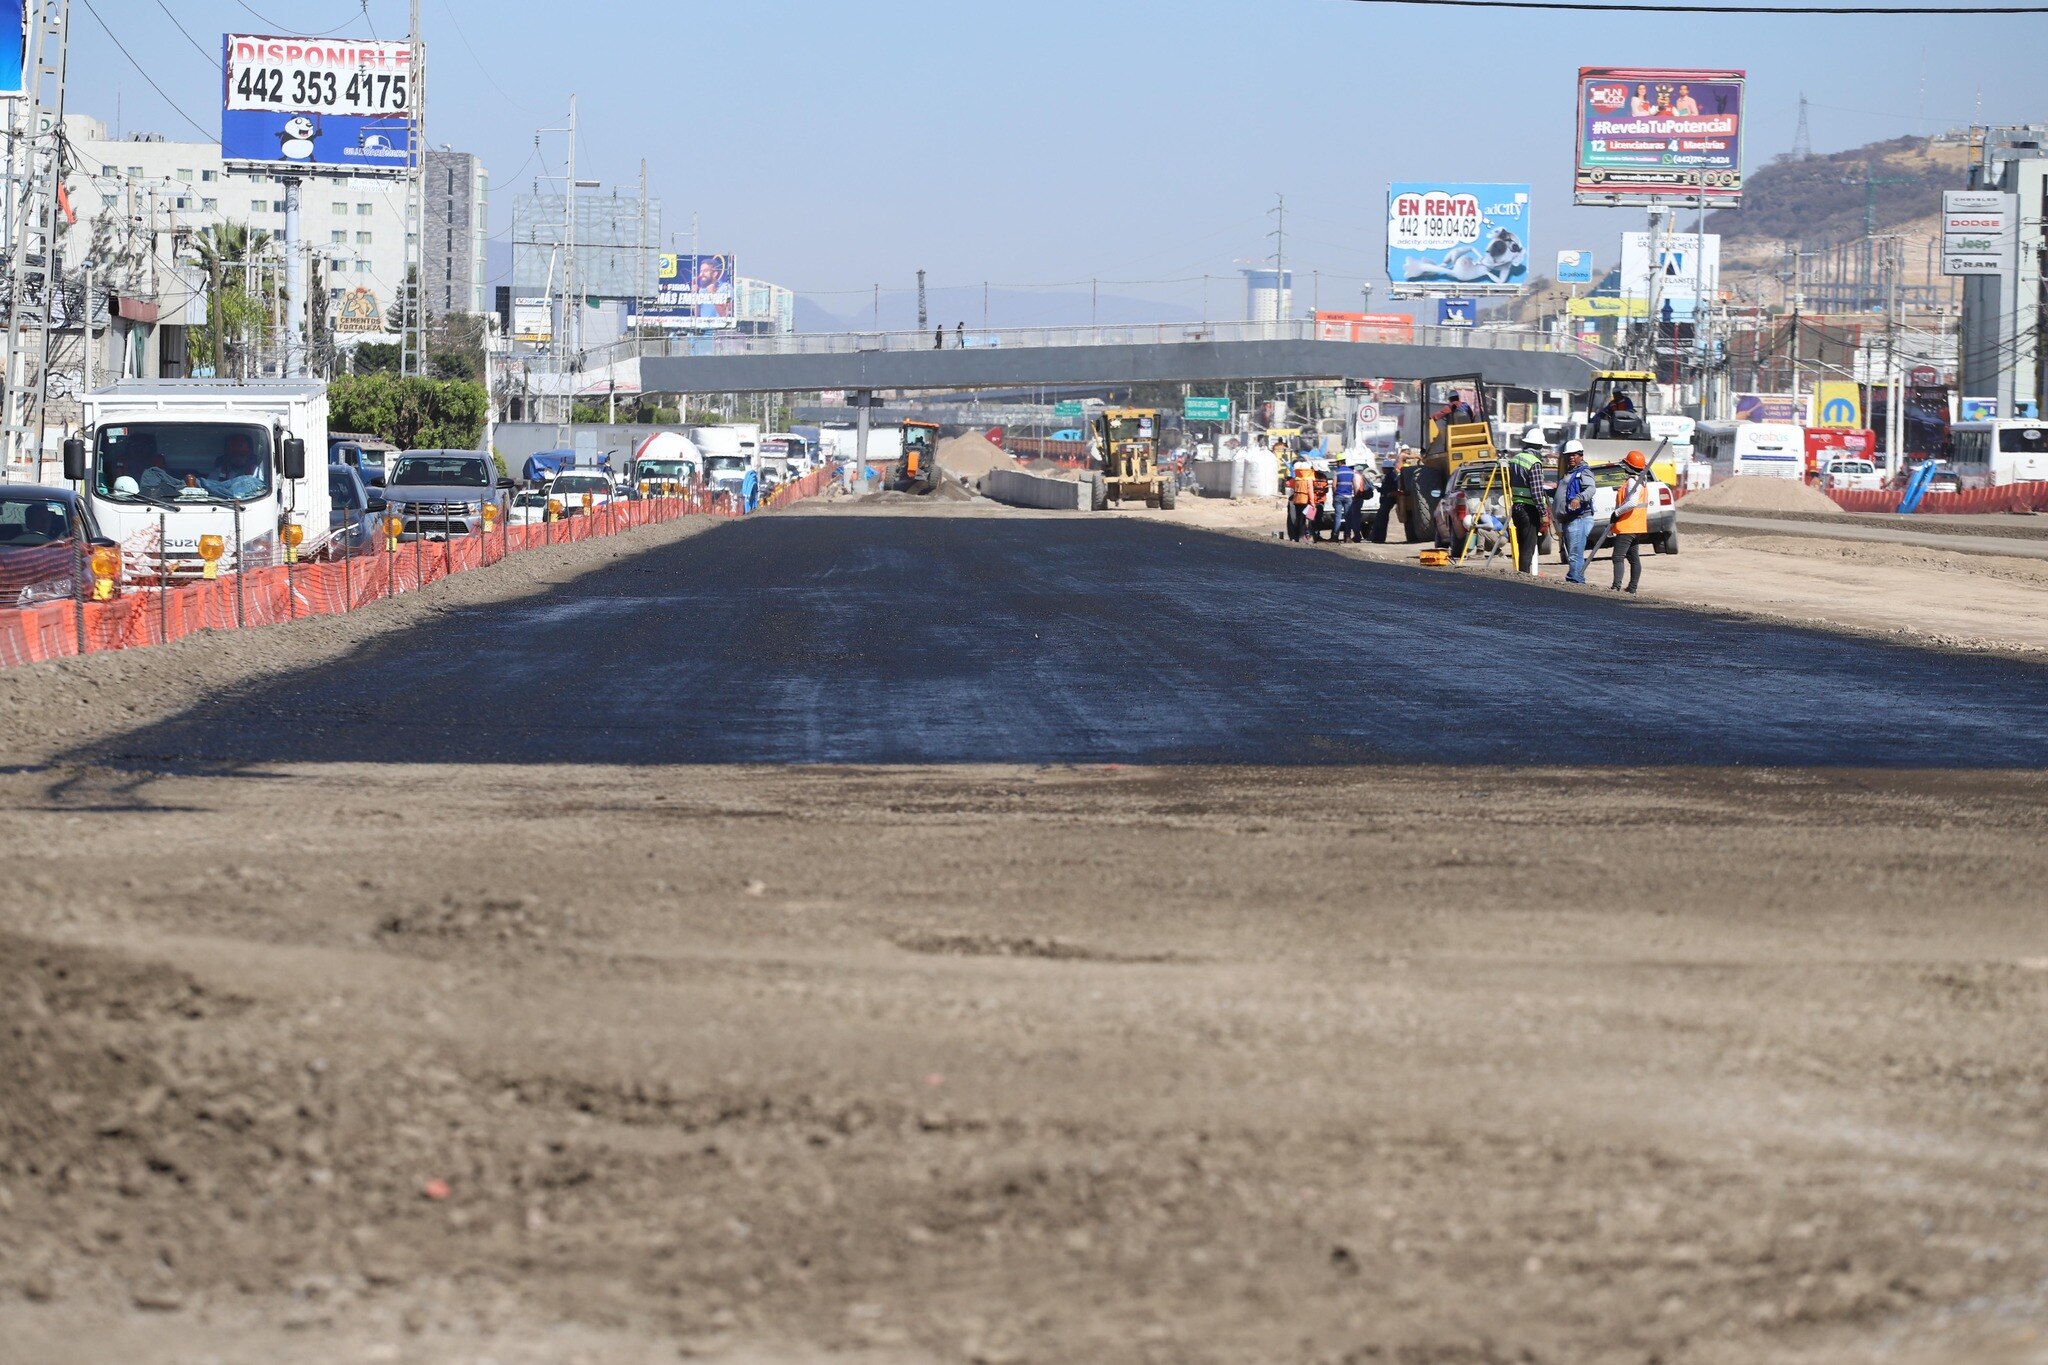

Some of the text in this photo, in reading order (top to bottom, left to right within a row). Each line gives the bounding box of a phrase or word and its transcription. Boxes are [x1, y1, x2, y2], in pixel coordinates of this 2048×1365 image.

[236, 42, 411, 71] DISPONIBLE
[237, 67, 406, 109] 442 353 4175
[1592, 118, 1732, 134] #RevelaTuPotencial
[1591, 140, 1606, 152] 12
[1610, 140, 1665, 150] Licenciaturas
[1668, 140, 1679, 151] 4
[1398, 199, 1477, 216] EN RENTA
[1400, 218, 1476, 237] 442 199.04.62
[1957, 237, 1991, 251] Jeep
